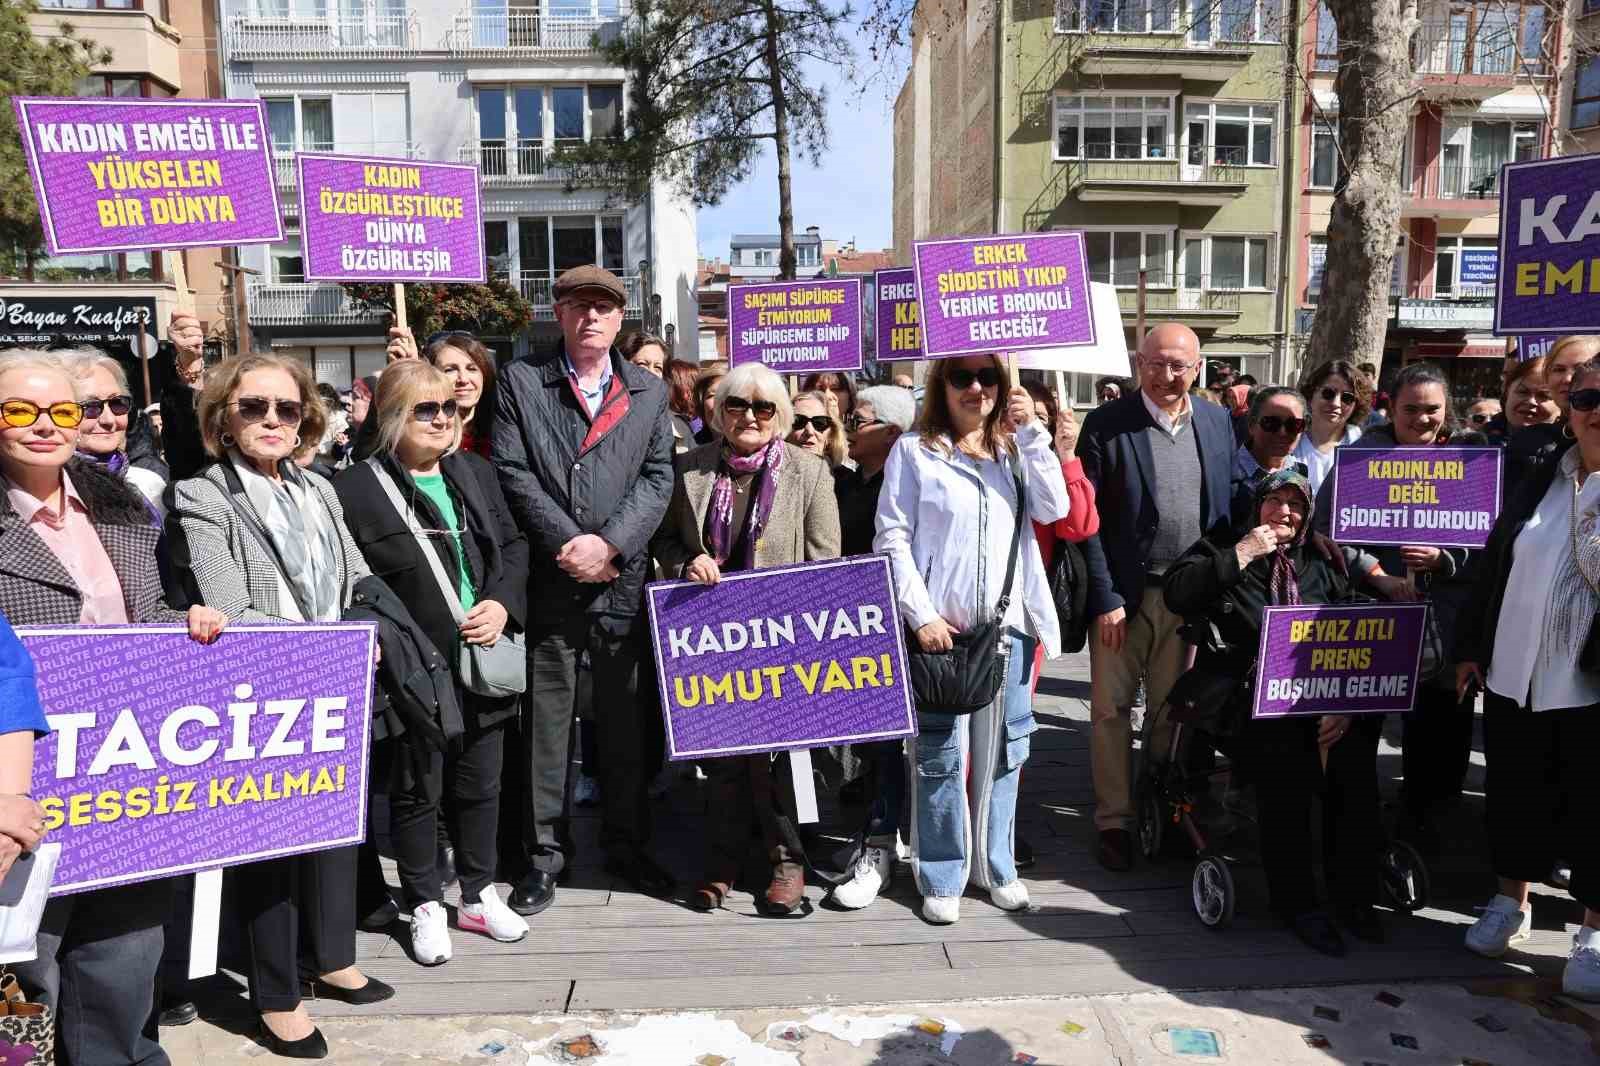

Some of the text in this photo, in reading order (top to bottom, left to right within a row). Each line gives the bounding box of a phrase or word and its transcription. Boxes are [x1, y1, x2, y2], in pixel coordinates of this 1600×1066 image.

[37, 116, 258, 152] KADIN EMEĞİ İLE
[88, 155, 222, 189] YÜKSELEN
[364, 165, 421, 188] KADIN
[97, 191, 236, 228] BİR DÜNYA
[320, 186, 464, 224] ÖZGÜRLEŞTİKÇE
[1519, 191, 1600, 245] KA
[365, 217, 426, 244] DÜNYA
[342, 245, 452, 277] ÖZGÜRLEŞİR
[973, 243, 1028, 265] ERKEK
[880, 283, 916, 301] ERKE
[938, 265, 1068, 298] ŞİDDETİNİ YIKIP
[744, 288, 845, 313] SAÇIMI SÜPÜRGE
[895, 302, 920, 325] KA
[939, 286, 1072, 319] YERİNE BROKOLİ
[7, 303, 68, 330] Bayan
[758, 308, 832, 327] ETMİYORUM
[969, 313, 1049, 341] EKECEĞİZ
[741, 324, 850, 346] SÜPÜRGEME BİNİP
[762, 347, 829, 368] UÇUYORUM
[1368, 460, 1464, 480] KADINLARI
[1388, 481, 1440, 504] DEĞİL
[1340, 505, 1490, 532] ŞİDDETİ DURDUR
[668, 604, 887, 658] KADIN VAR
[1289, 618, 1395, 643] BEYAZ ATLI
[34, 640, 133, 673] İRLİKTE DAHA
[48, 655, 121, 684] GÜÇLÜYÜZ
[1311, 647, 1372, 672] PRENS
[101, 664, 138, 682] DAHA
[673, 653, 894, 708] UMUT VAR!
[55, 681, 128, 710] GÜÇLÜYÜZ
[1266, 675, 1408, 706] BOŞUNA GELME
[47, 683, 348, 779] TACİZE
[41, 765, 347, 831] SESSİZ KALMA!
